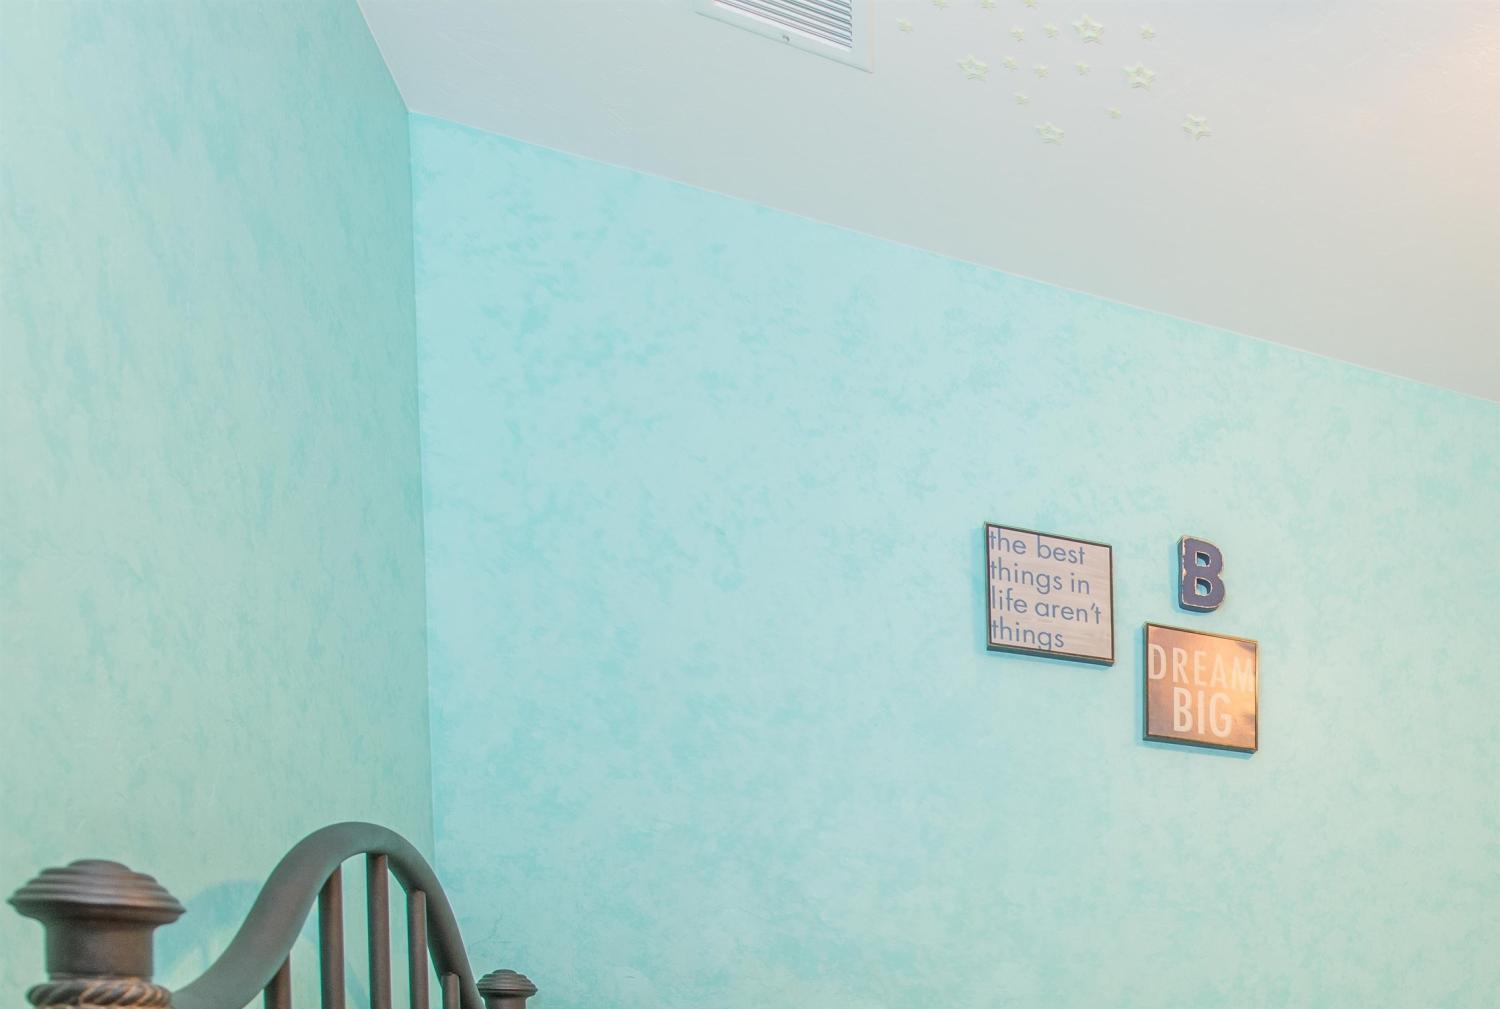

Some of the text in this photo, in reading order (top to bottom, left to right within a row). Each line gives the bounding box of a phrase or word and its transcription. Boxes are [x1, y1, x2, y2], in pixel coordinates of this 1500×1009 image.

[989, 528, 1085, 565] the best
[990, 557, 1090, 595] things in
[1178, 535, 1225, 612] B
[991, 585, 1102, 625] life aren't
[992, 616, 1064, 650] things
[1148, 643, 1256, 693] DREAM
[1173, 686, 1233, 738] BIG
